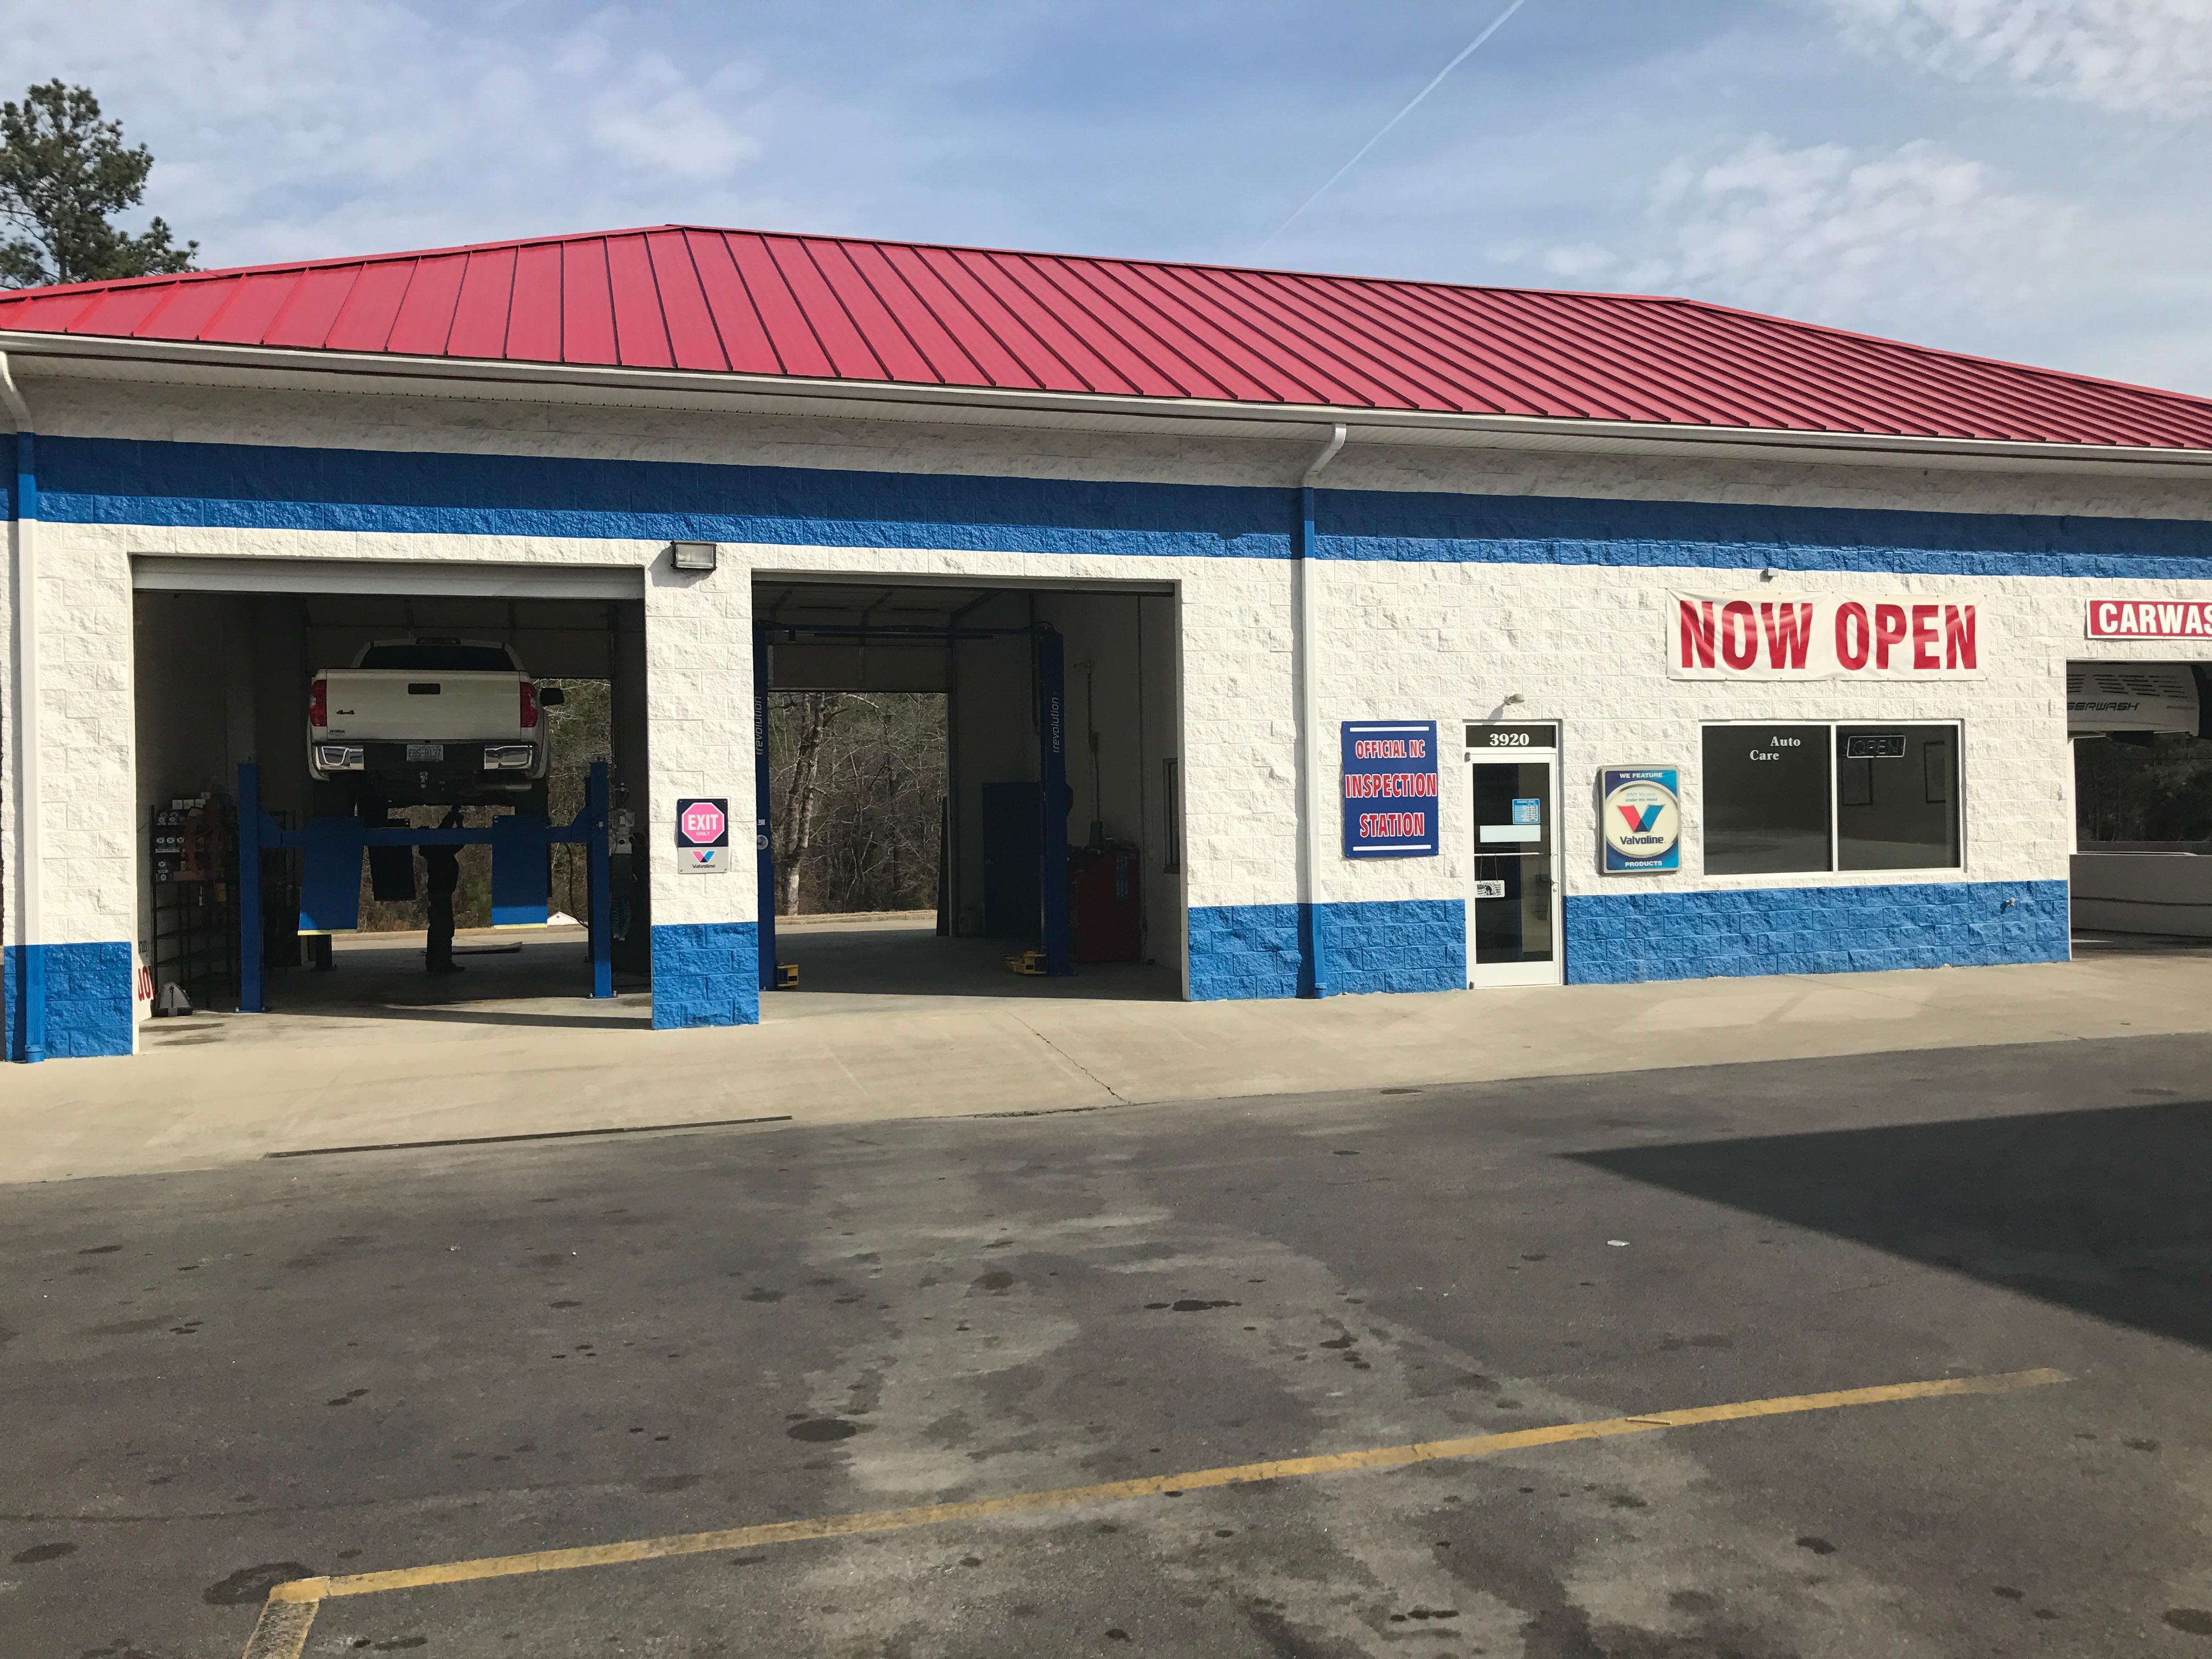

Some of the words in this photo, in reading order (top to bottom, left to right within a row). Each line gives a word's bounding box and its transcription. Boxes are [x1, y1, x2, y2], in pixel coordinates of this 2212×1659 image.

[1680, 601, 1813, 670] NOW
[1835, 601, 1977, 670] OPEN
[754, 696, 763, 751] revolution
[1051, 697, 1060, 749] revolution
[1489, 733, 1530, 746] 3920
[1770, 736, 1801, 746] Auto
[1853, 739, 1899, 754] OPEN
[1355, 740, 1407, 759] OFFICIAL
[1409, 740, 1425, 758] NC
[1750, 749, 1779, 760] Care
[1345, 772, 1437, 798] INSPECTION
[688, 814, 718, 831] EXIT
[1359, 812, 1424, 838] STATION
[1620, 836, 1664, 845] Valvoline
